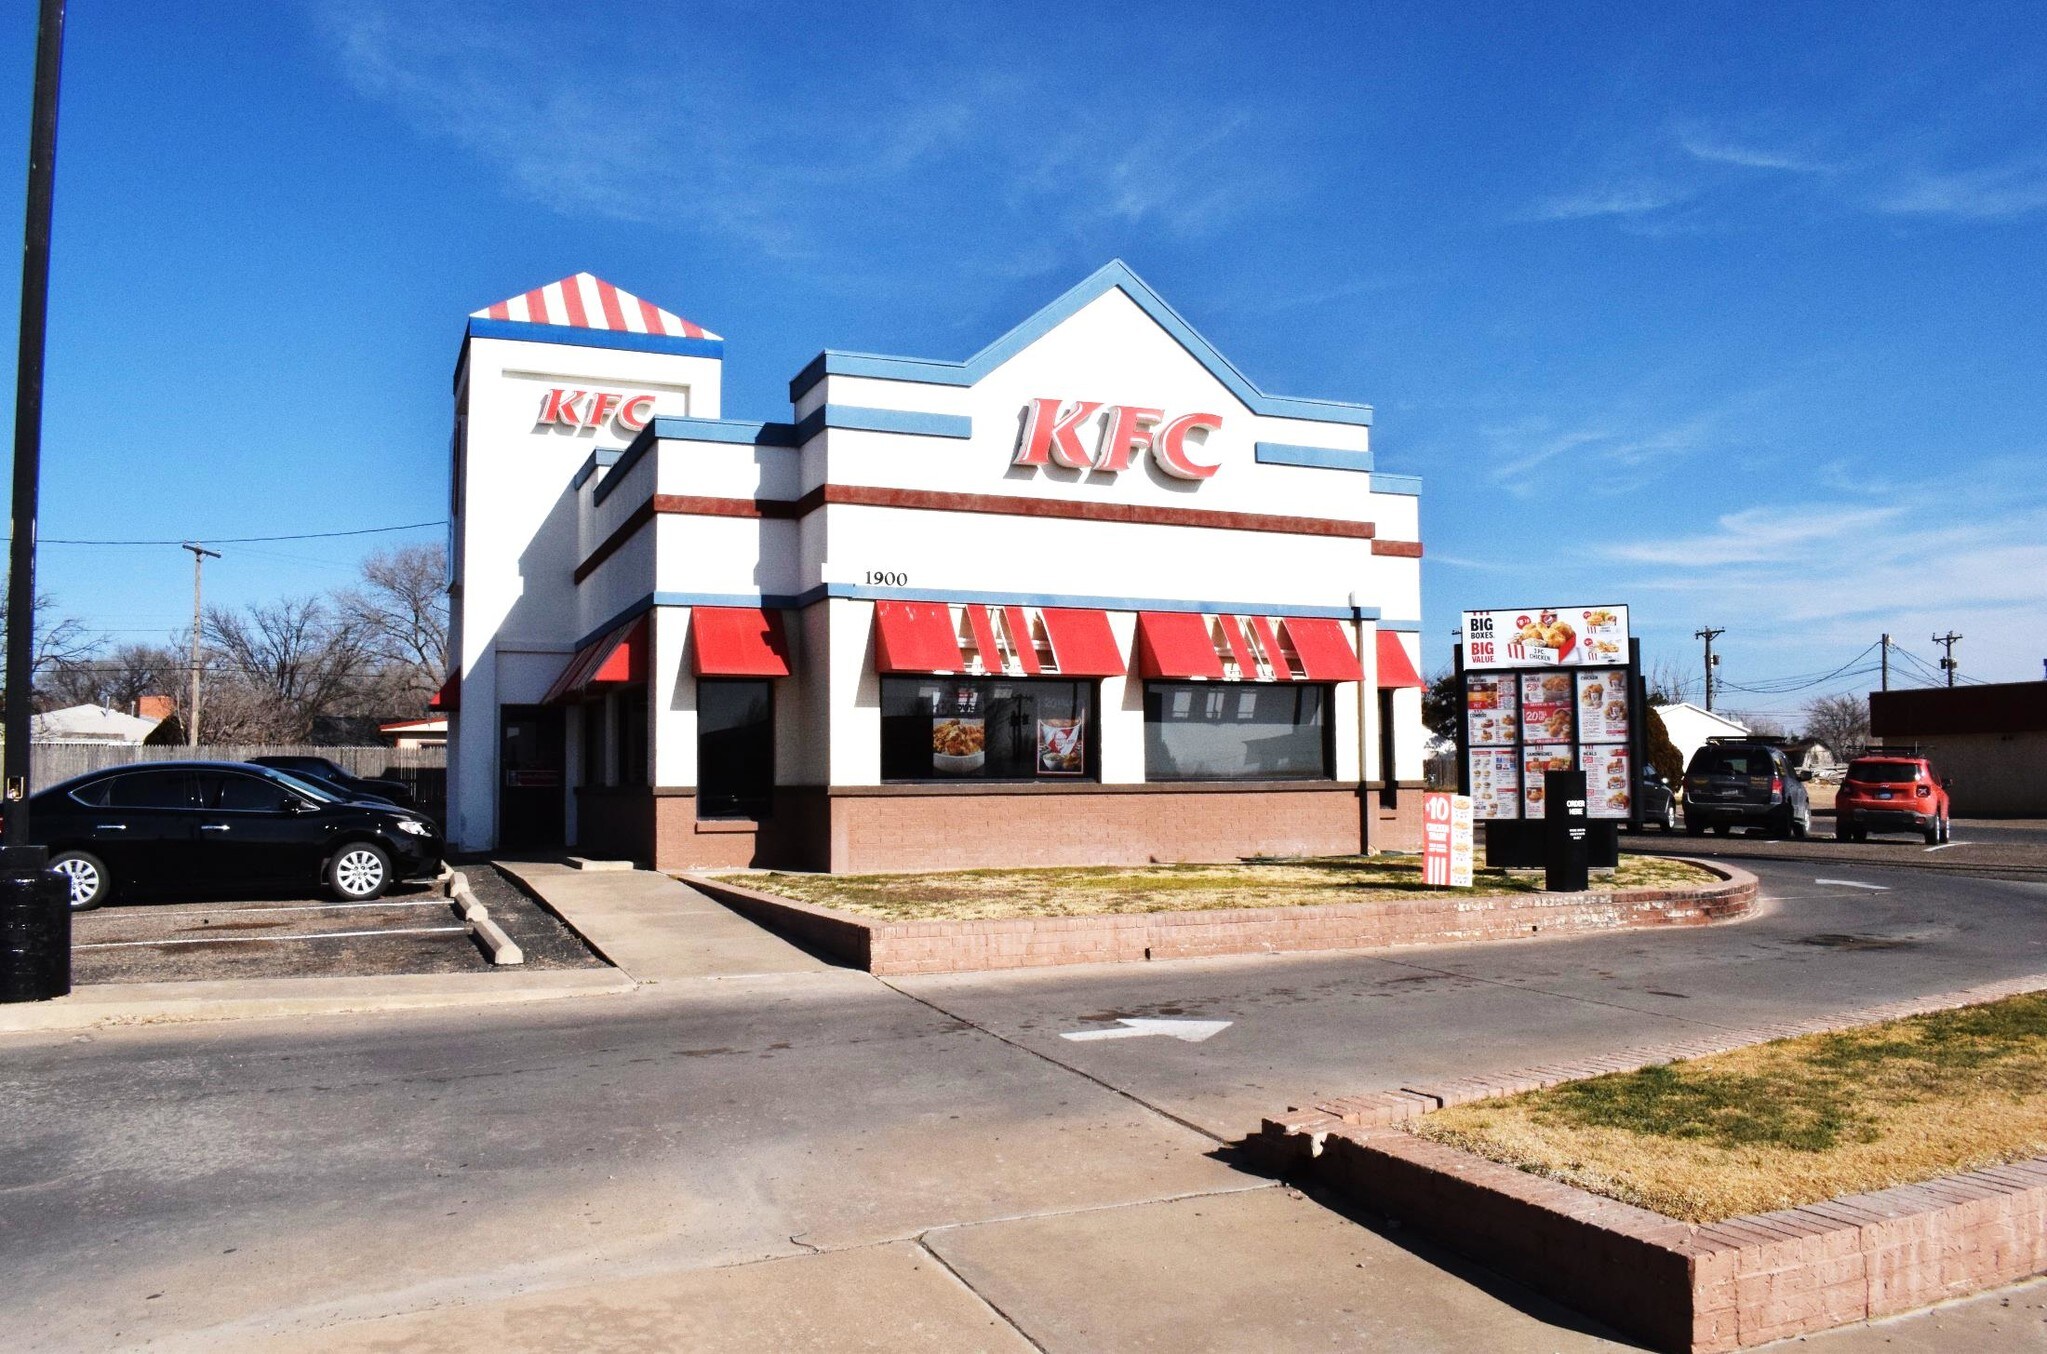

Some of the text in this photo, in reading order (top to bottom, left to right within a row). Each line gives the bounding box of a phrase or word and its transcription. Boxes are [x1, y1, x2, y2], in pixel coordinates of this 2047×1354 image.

[537, 388, 656, 432] KFC
[1012, 397, 1224, 480] KFC
[865, 570, 908, 587] 1900
[1470, 617, 1493, 632] BIG
[1471, 641, 1494, 656] BIG
